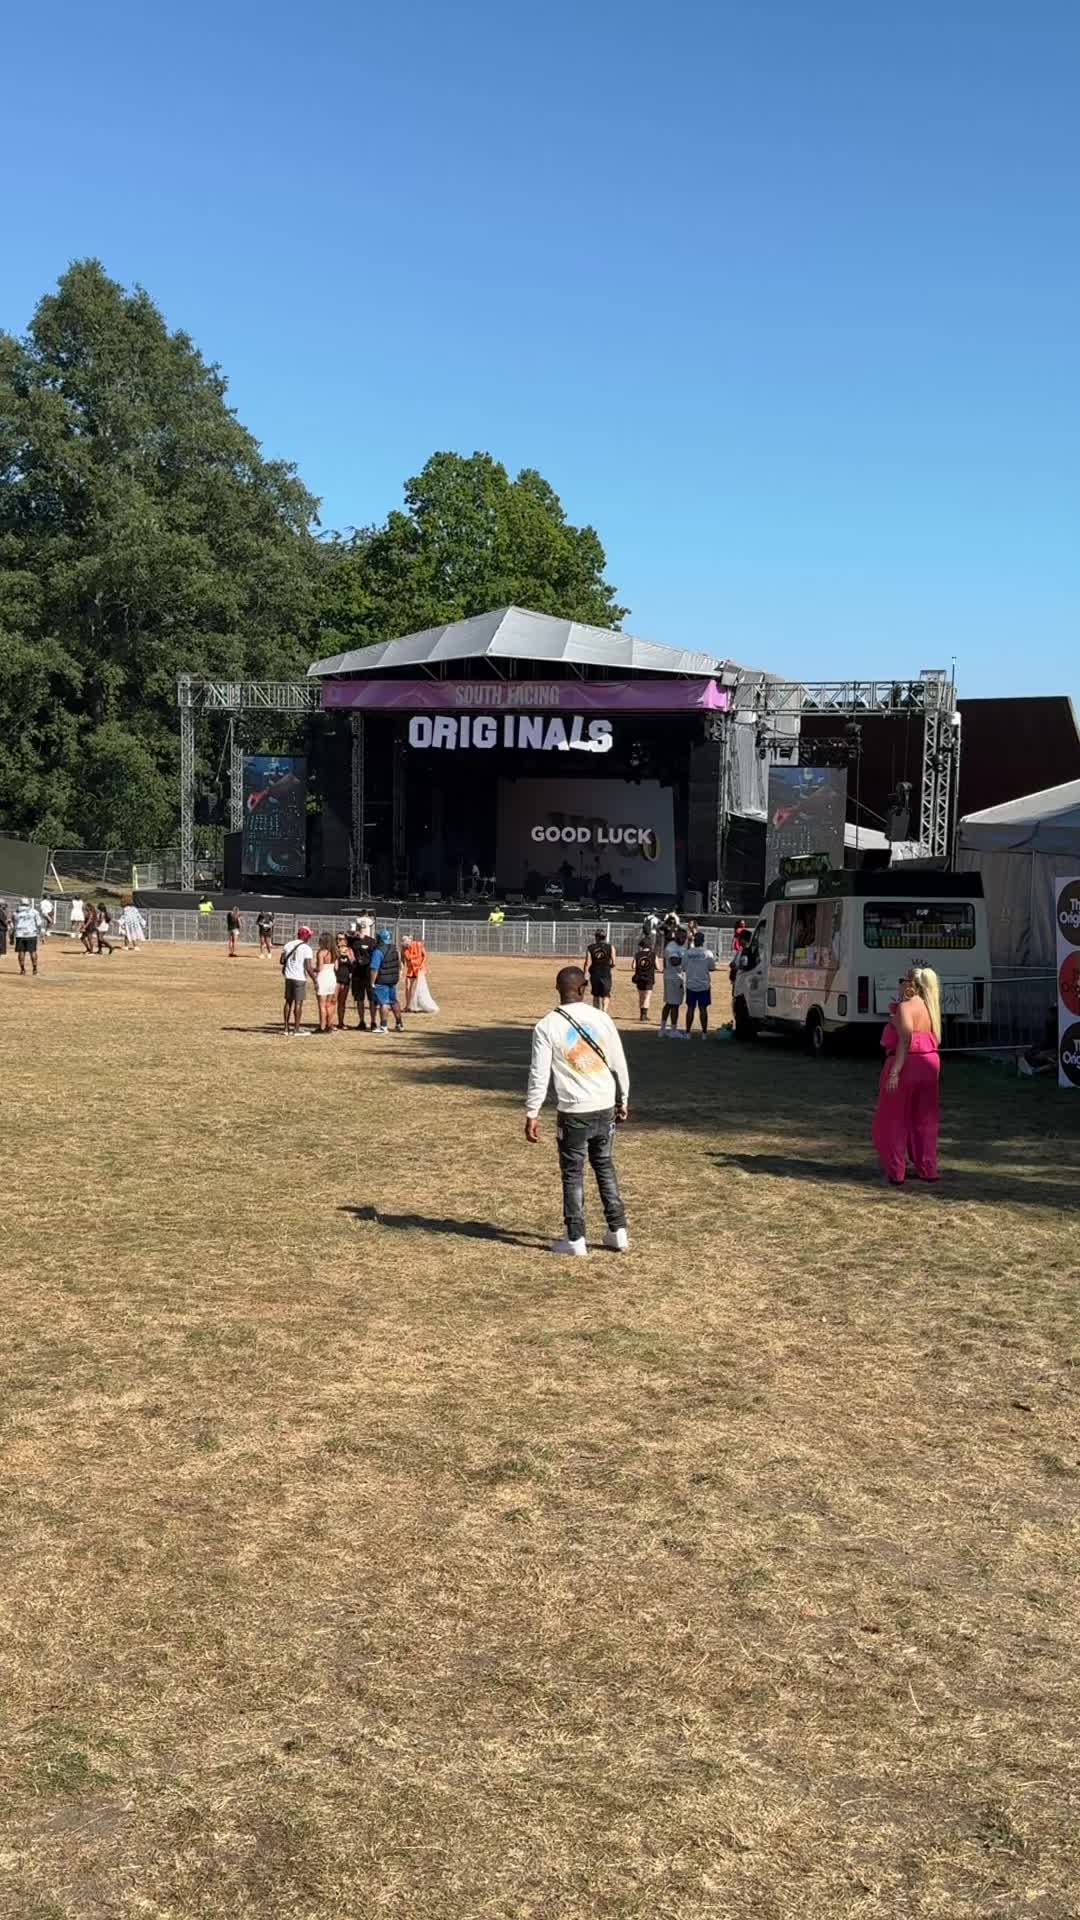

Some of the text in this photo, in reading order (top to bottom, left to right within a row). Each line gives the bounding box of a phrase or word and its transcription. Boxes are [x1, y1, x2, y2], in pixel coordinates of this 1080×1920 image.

[456, 685, 560, 706] SOUTH FACING
[408, 715, 613, 753] ORIGINALS
[531, 825, 652, 845] GOOD LUCK
